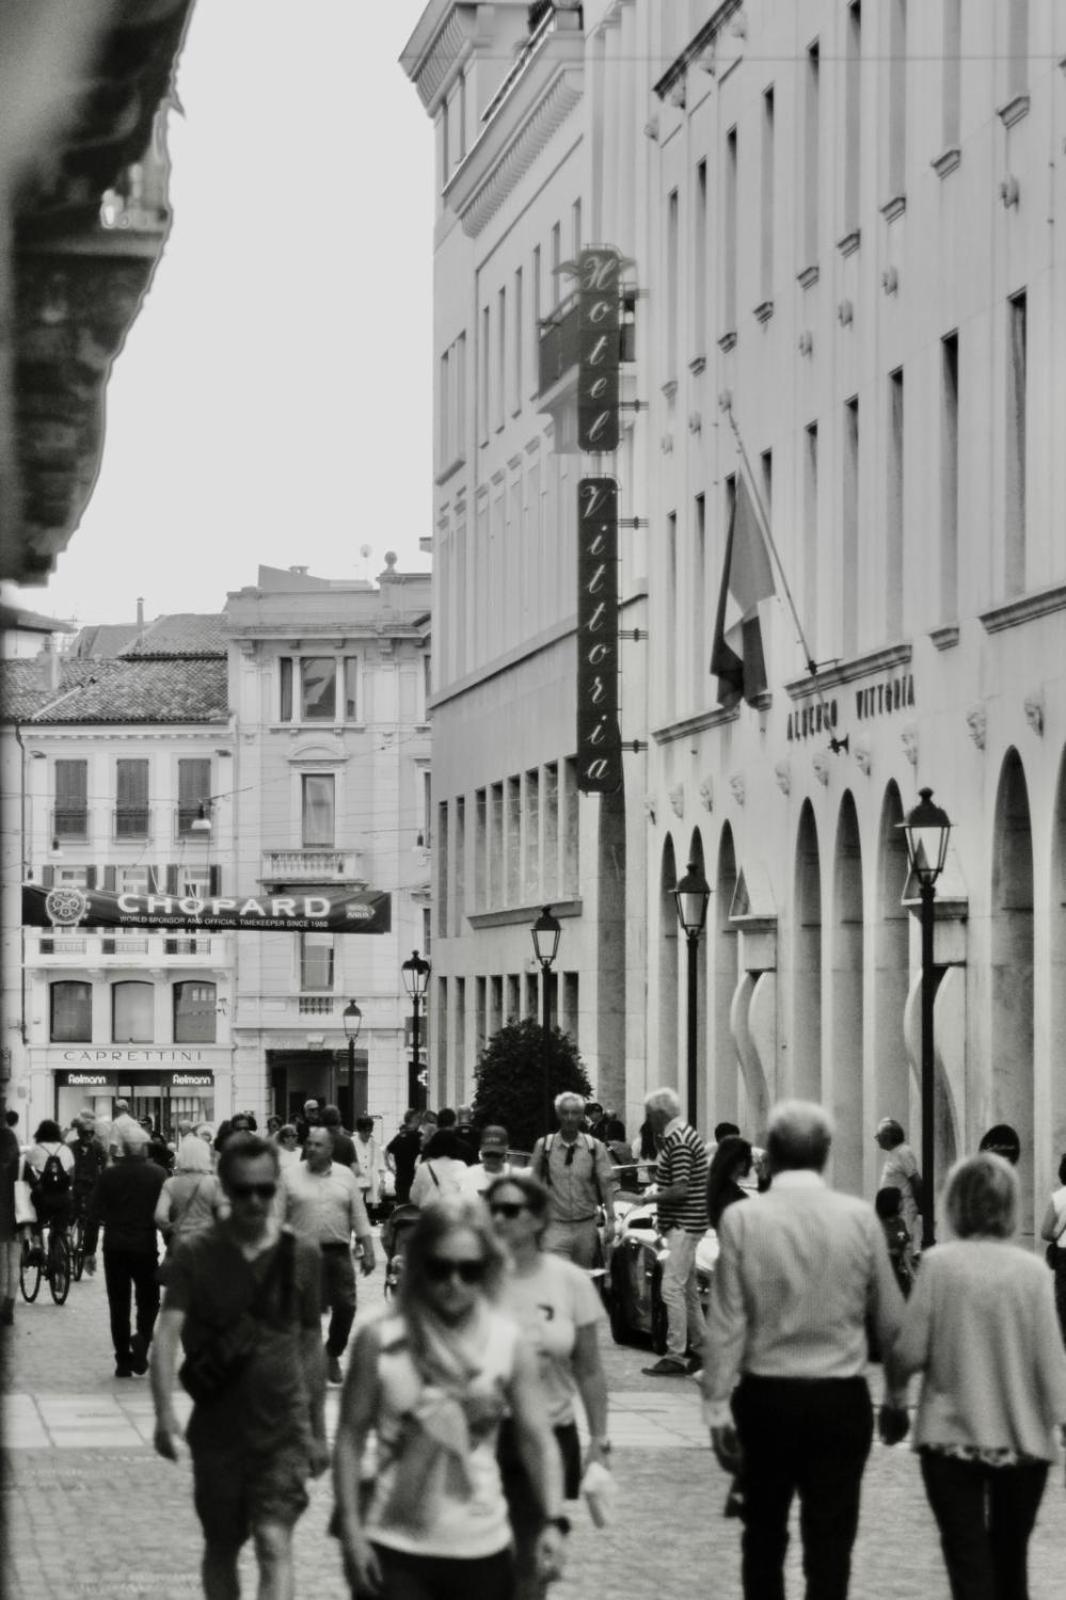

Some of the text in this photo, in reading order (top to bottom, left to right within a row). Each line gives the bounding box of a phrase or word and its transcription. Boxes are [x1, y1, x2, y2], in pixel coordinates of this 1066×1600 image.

[580, 255, 617, 779] Hotel Vittoria
[856, 674, 915, 720] VITTORIA
[117, 893, 331, 917] CHOPARD
[120, 915, 147, 923] WORLD
[149, 916, 186, 924] SPONSOR
[204, 918, 236, 926] OFFICIAL
[239, 919, 285, 927] TIMEKEEPER
[287, 920, 310, 928] SINCE
[64, 1051, 202, 1062] CAPRETTINI
